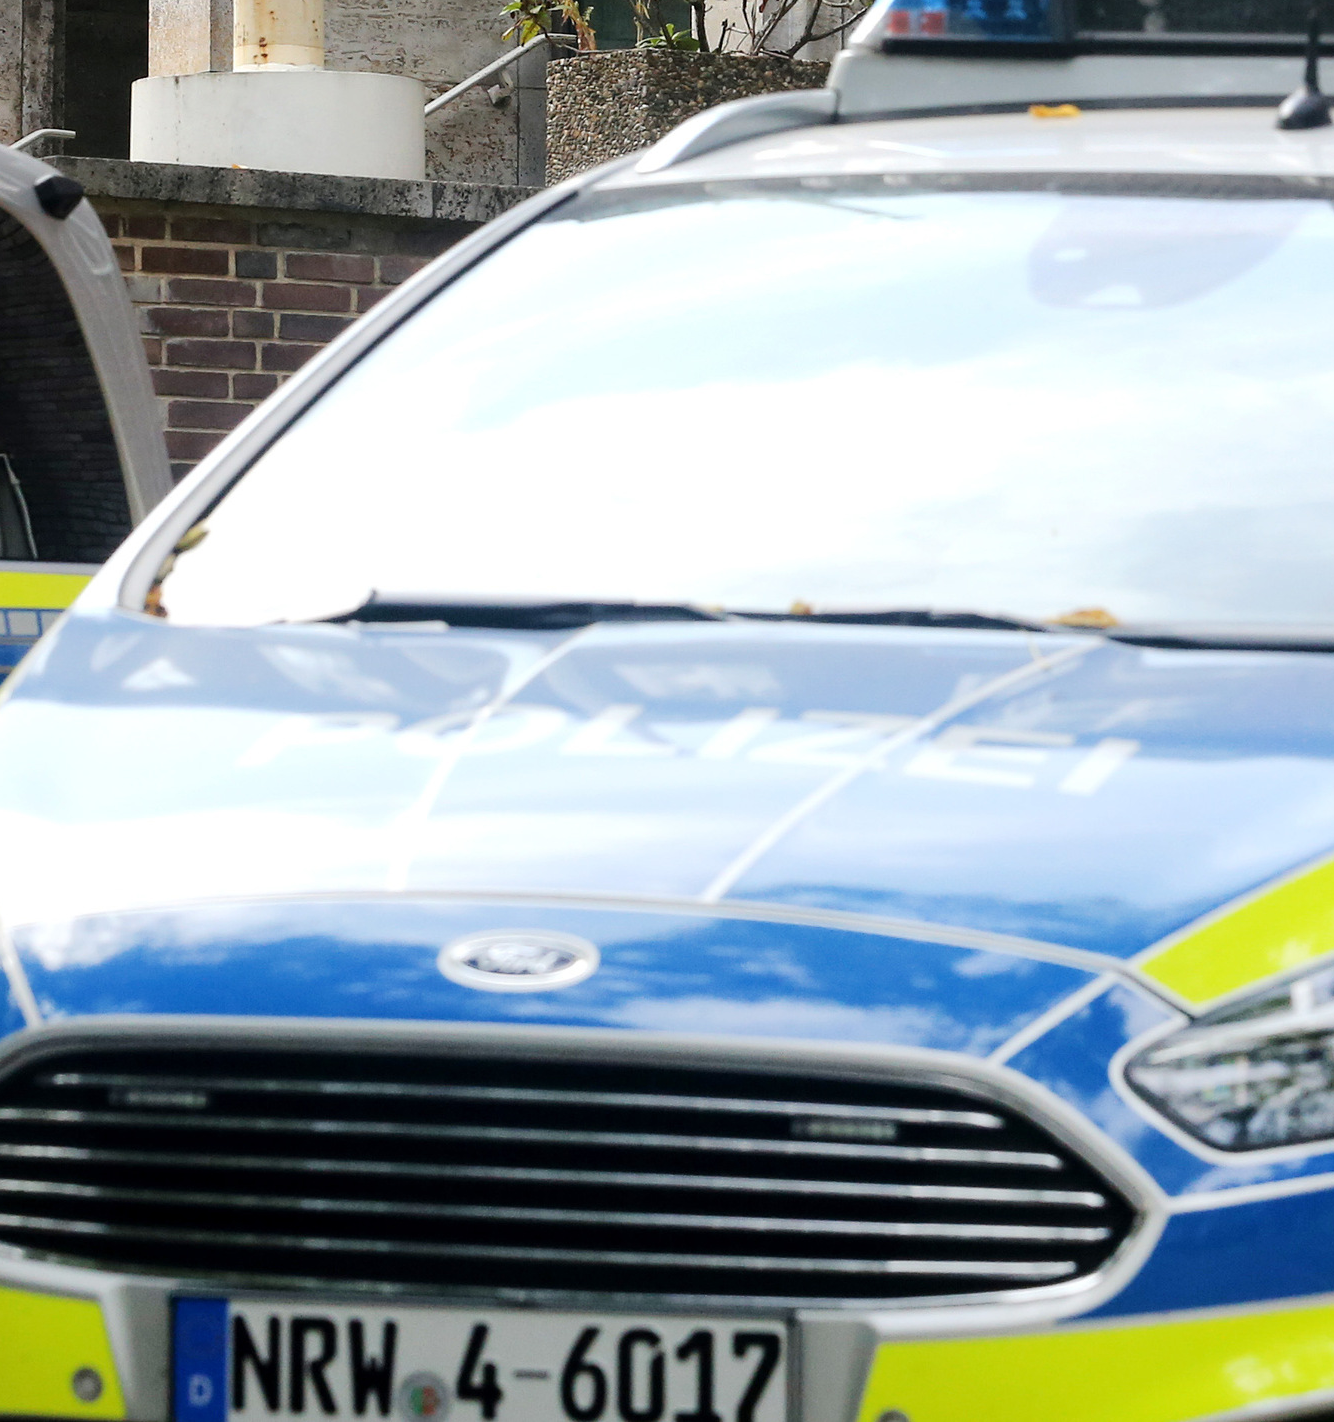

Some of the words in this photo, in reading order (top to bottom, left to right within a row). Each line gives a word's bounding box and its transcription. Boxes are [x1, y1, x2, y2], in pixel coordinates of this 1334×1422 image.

[234, 704, 1142, 796] POLIZEI
[187, 1375, 213, 1408] D
[231, 1315, 398, 1416] NRW
